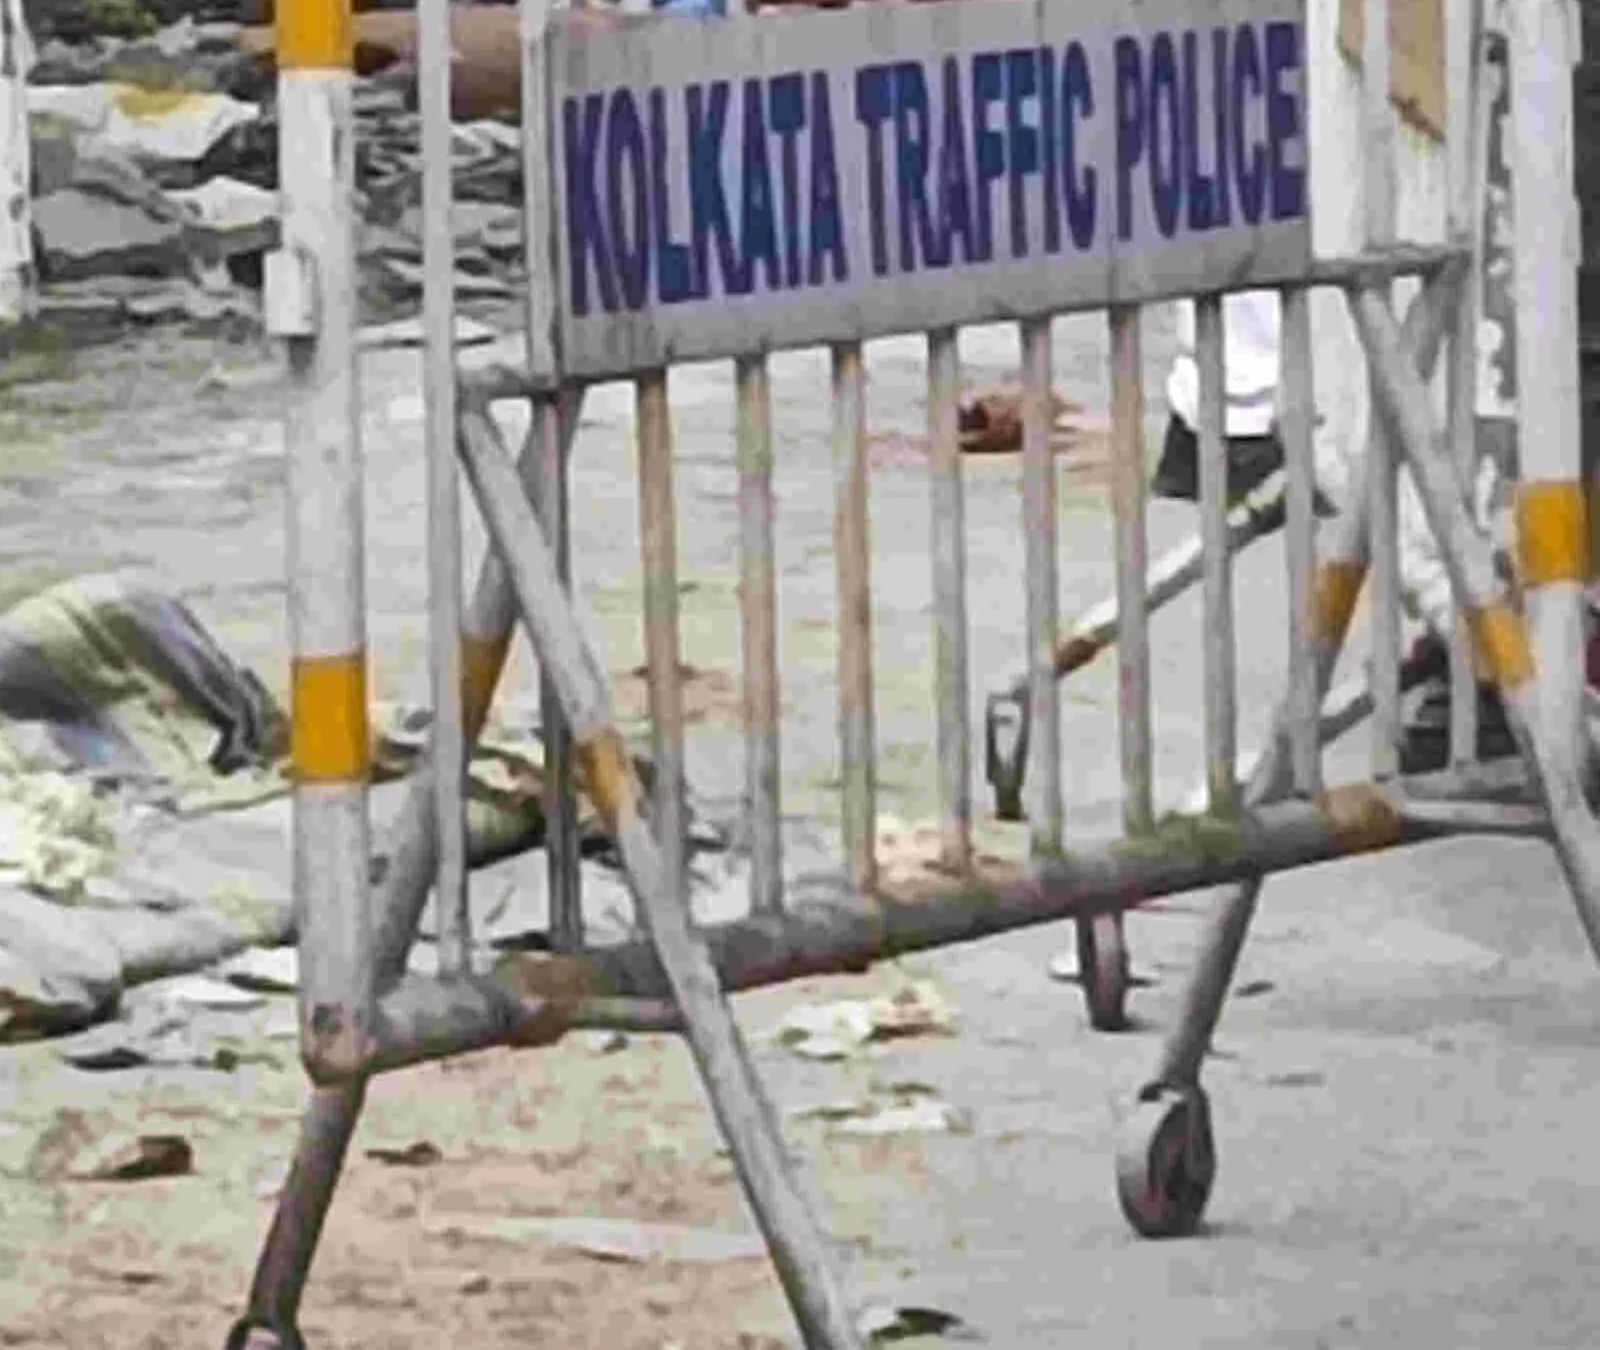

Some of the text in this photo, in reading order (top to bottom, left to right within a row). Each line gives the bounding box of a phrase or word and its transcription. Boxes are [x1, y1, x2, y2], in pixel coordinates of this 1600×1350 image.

[563, 22, 1305, 317] KOLKATA TRAFFIC POLICE
